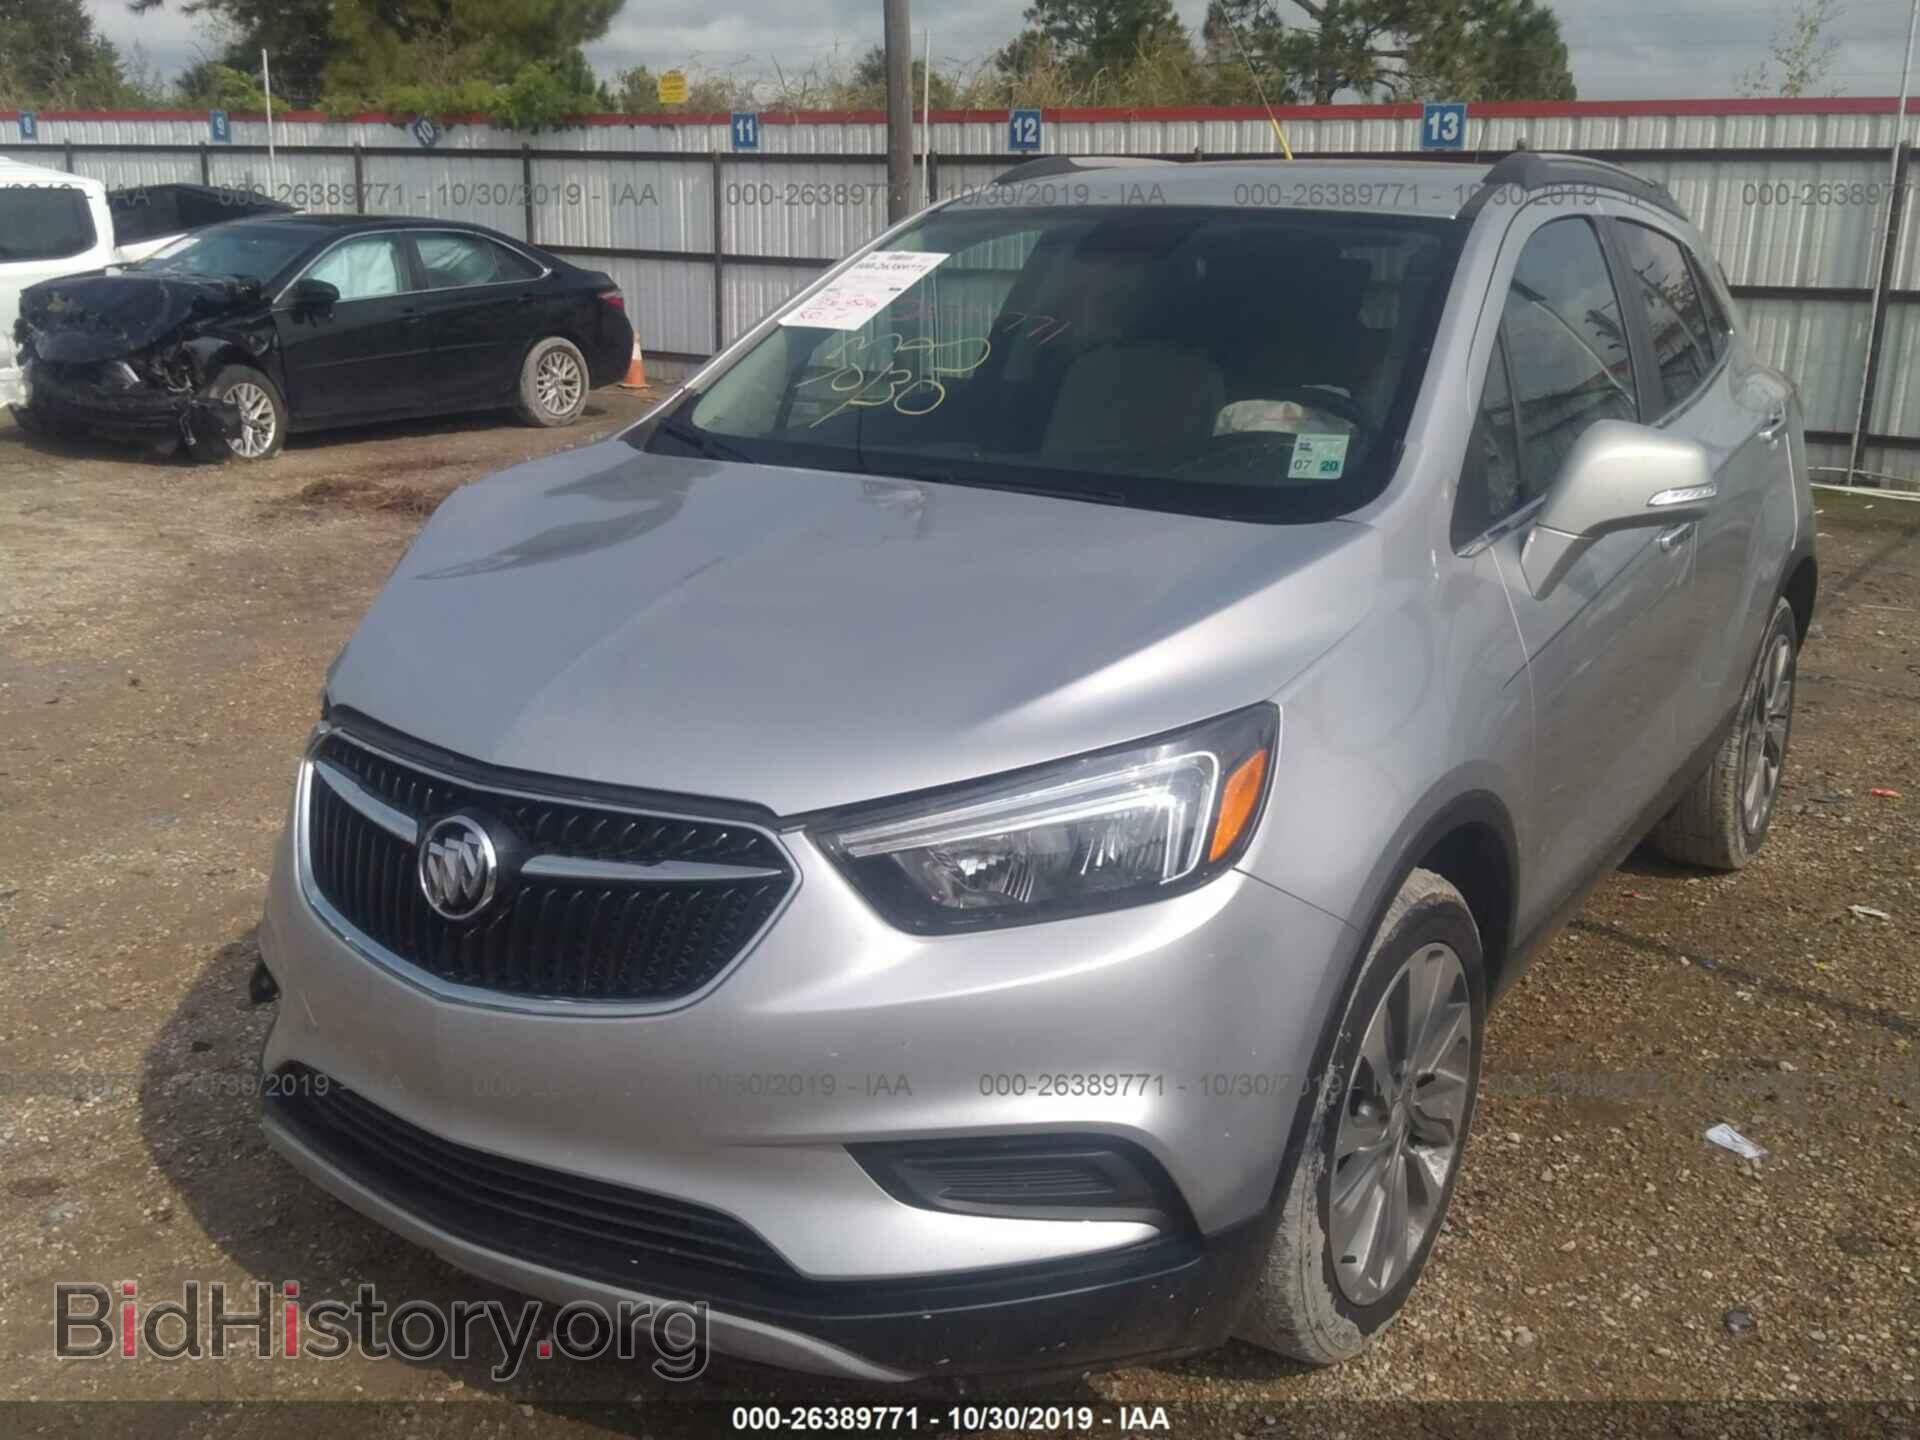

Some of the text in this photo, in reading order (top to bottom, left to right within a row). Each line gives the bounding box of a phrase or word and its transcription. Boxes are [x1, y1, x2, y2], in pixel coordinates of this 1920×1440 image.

[736, 118, 754, 143] 11
[1013, 117, 1037, 143] 12
[1428, 111, 1459, 140] 13
[1294, 459, 1338, 472] 07 20
